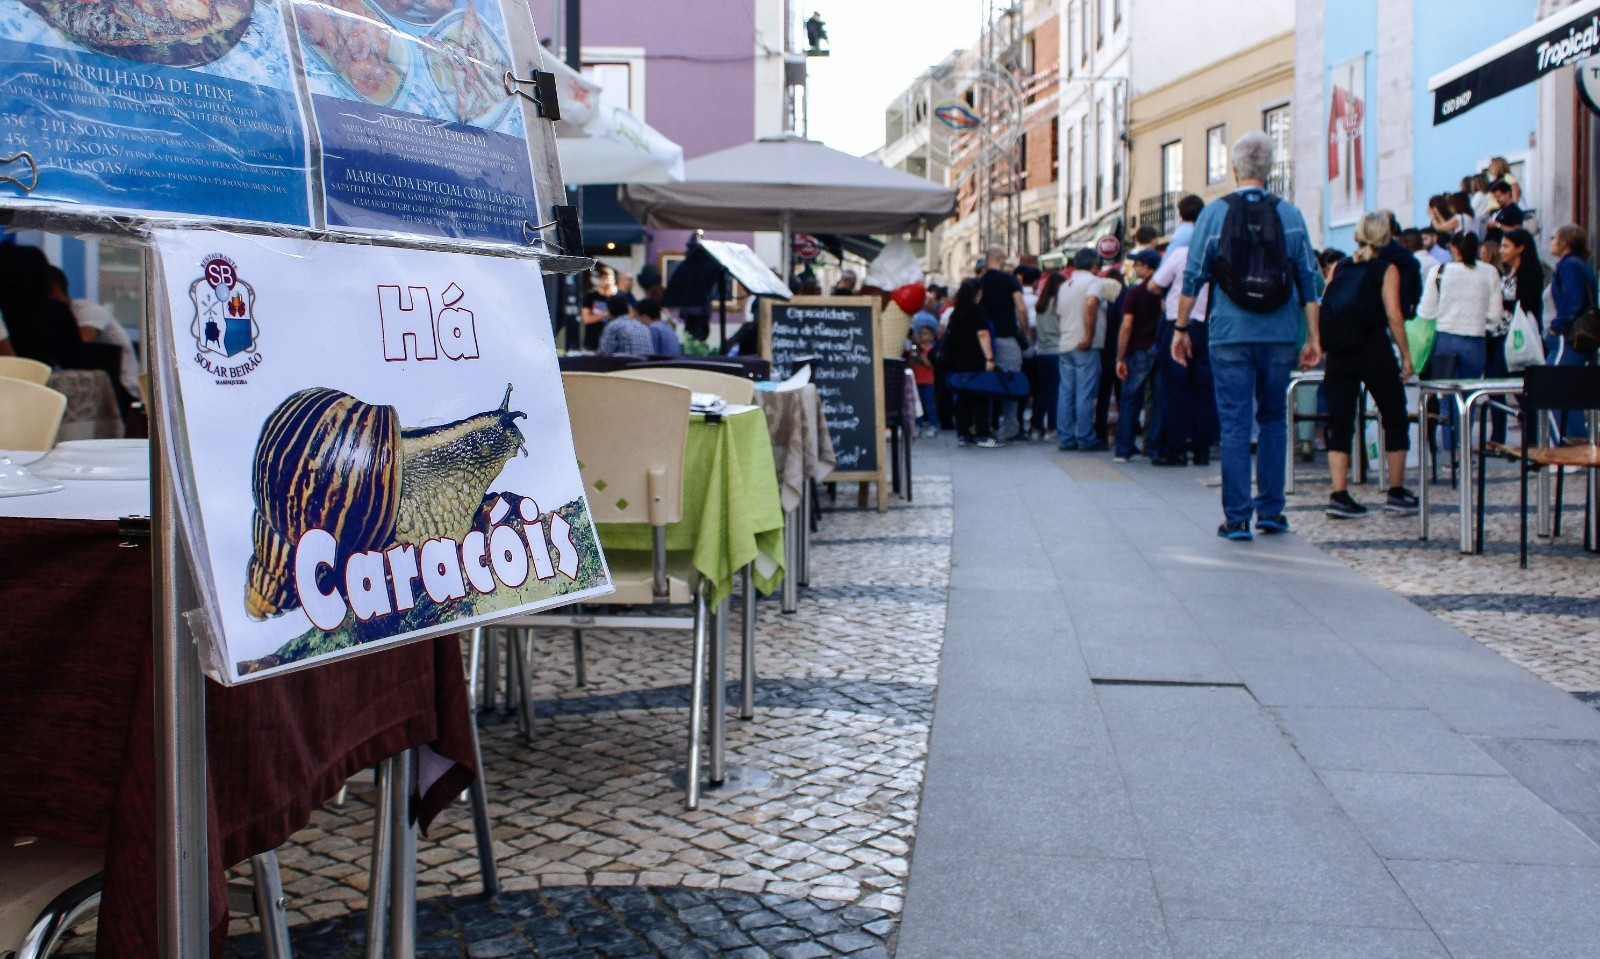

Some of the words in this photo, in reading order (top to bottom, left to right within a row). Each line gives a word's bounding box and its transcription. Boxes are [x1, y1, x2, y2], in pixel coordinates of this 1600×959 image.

[1536, 15, 1599, 71] Tropical
[53, 60, 165, 92] PARRILHADA
[170, 79, 191, 95] DE
[195, 83, 235, 102] PEIXE
[380, 115, 443, 140] MARISCADA
[445, 131, 487, 149] ESPECIAL
[346, 168, 415, 191] MARISCADA
[417, 178, 463, 198] ESPECIAL
[463, 186, 486, 201] COM
[488, 191, 528, 209] LAGOSTA
[208, 264, 234, 287] SB
[377, 282, 480, 362] Há
[194, 352, 228, 378] SOLAR
[229, 352, 263, 378] BEIRÃO
[293, 495, 580, 632] Caracóis
